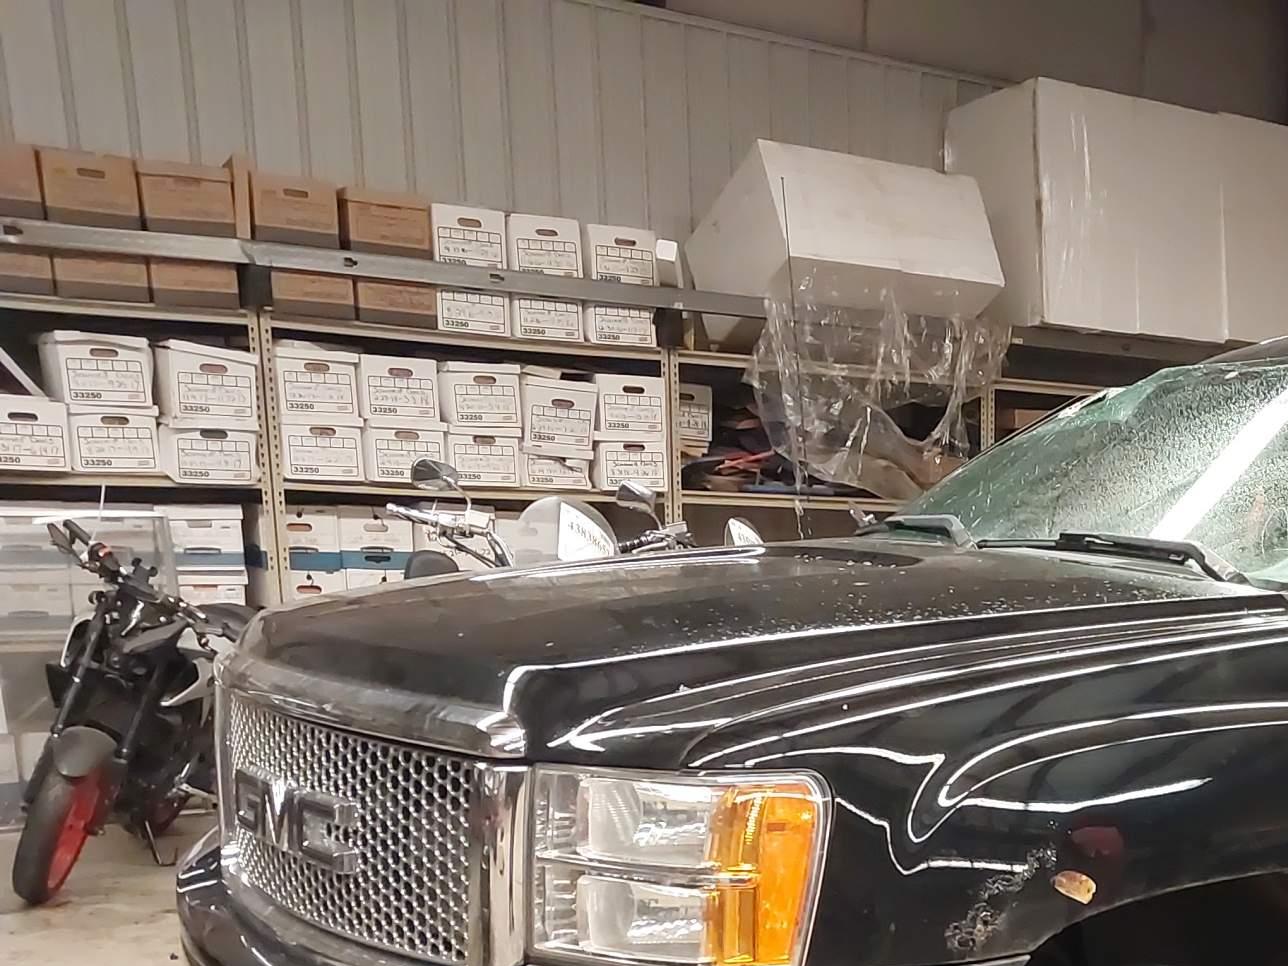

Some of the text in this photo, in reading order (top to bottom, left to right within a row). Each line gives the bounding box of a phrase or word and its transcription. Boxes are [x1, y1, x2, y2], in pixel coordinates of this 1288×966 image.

[445, 319, 469, 328] 33250
[522, 327, 546, 335] 33250
[598, 333, 621, 341] 33250
[73, 391, 103, 399] 33250
[182, 404, 210, 413] 33250
[288, 402, 315, 410] 33250
[372, 406, 398, 414] 33250
[532, 433, 556, 441] 33250
[182, 470, 210, 478] 33250
[293, 466, 320, 474] 33250
[380, 469, 405, 477] 33250
[236, 766, 358, 874] GMC
